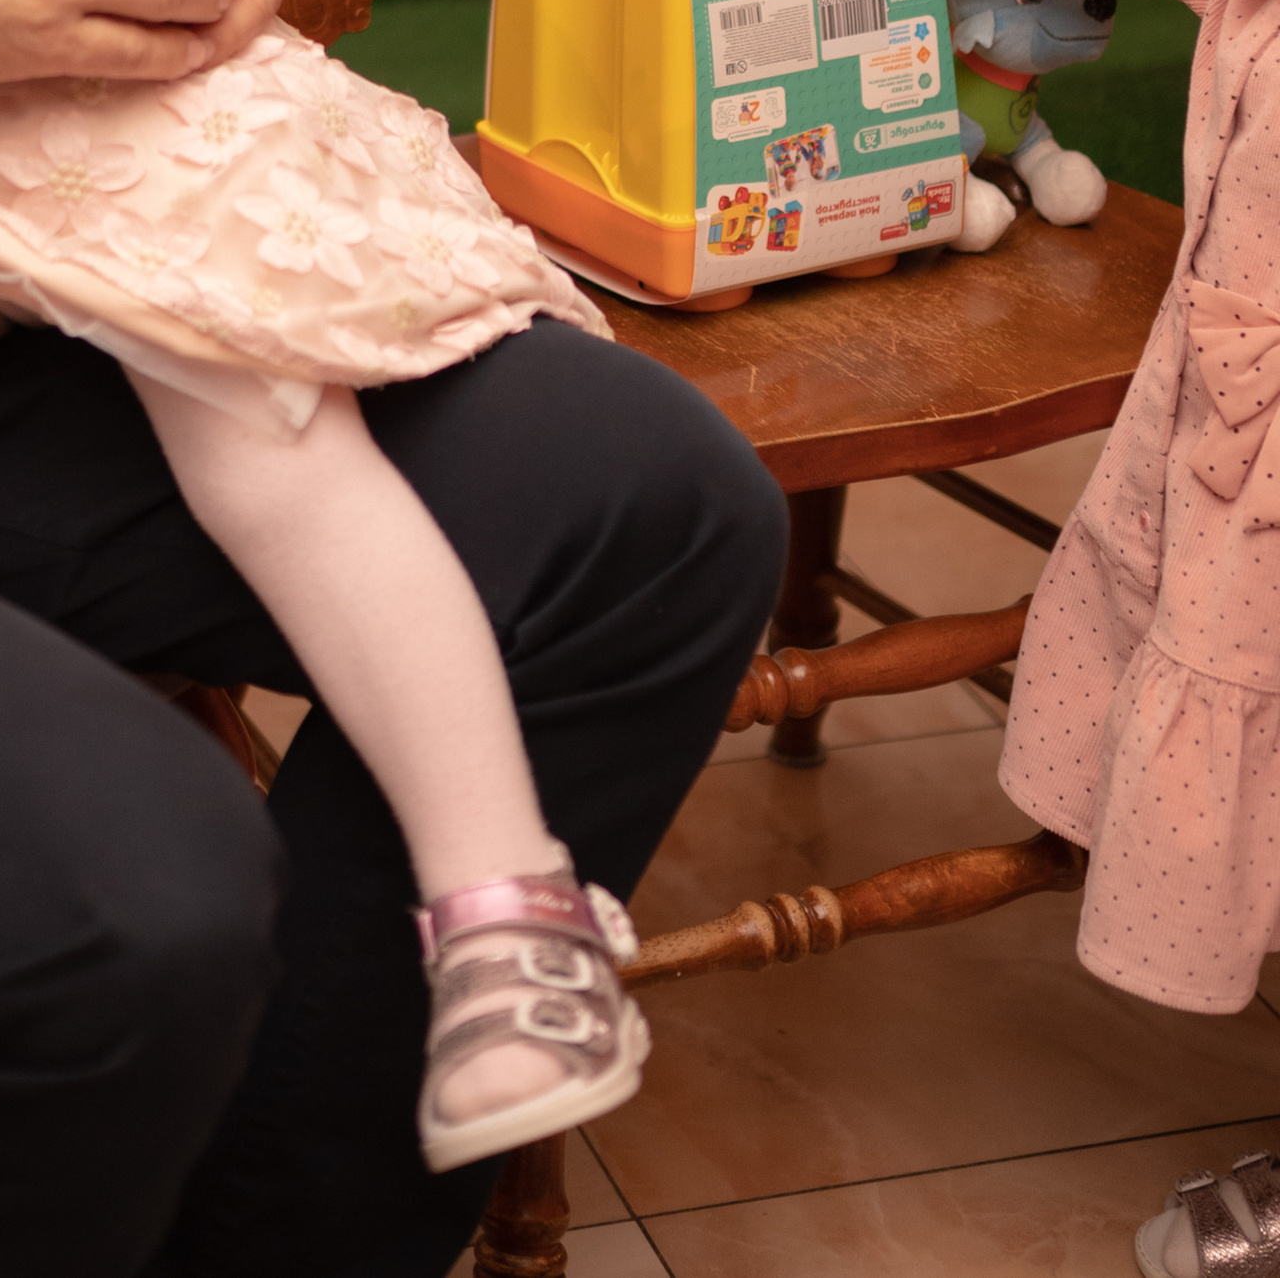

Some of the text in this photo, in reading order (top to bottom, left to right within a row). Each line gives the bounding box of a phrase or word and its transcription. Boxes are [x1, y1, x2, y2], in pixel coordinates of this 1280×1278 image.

[749, 101, 761, 122] 2
[890, 120, 945, 138] Фруктобус
[864, 134, 877, 147] 26
[815, 195, 881, 215] конструктор
[818, 205, 880, 226] Мой первый
